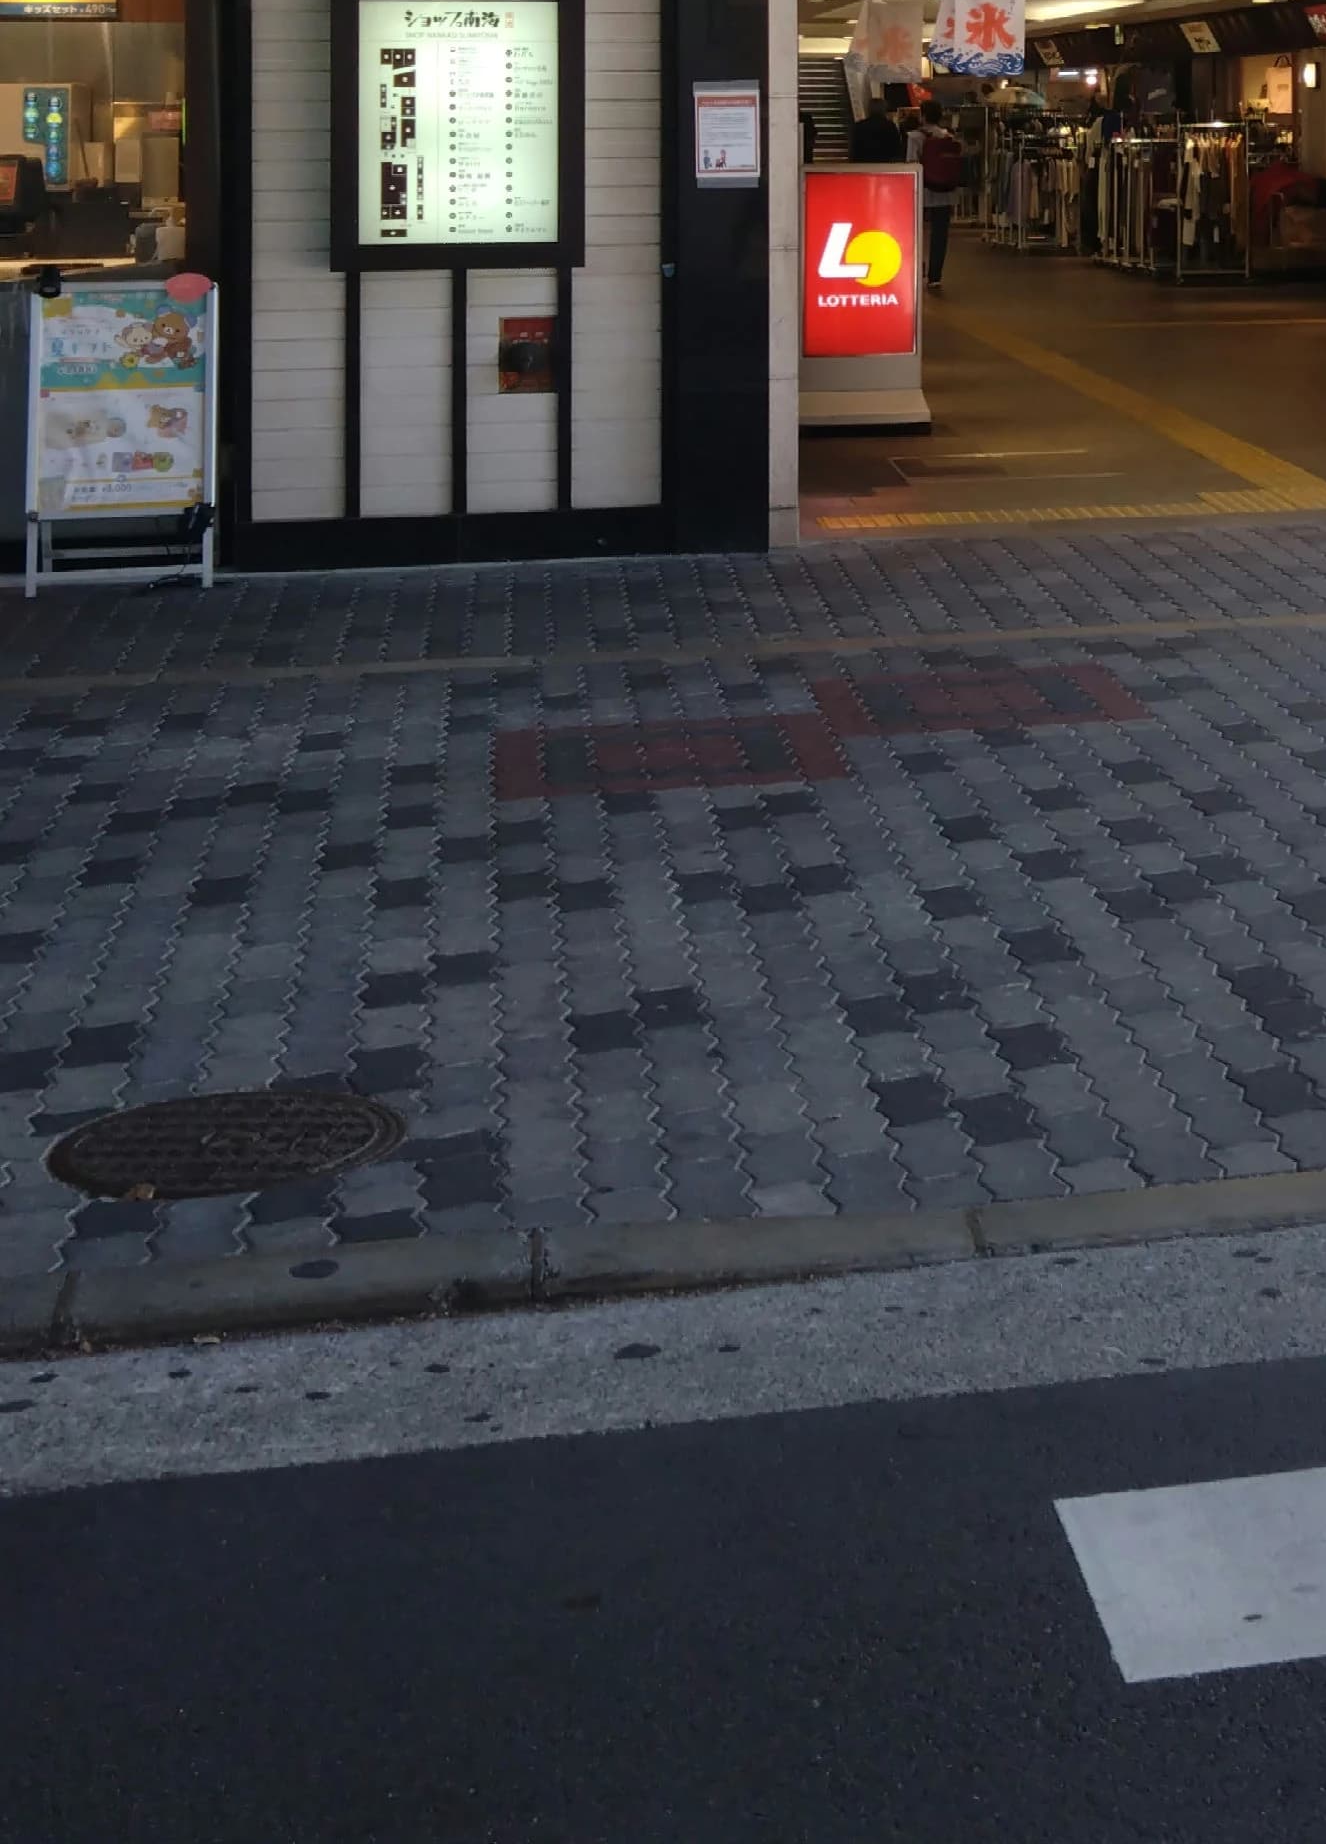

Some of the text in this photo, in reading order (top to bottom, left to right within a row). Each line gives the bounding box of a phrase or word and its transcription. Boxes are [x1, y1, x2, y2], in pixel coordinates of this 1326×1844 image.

[404, 10, 500, 28] ショップ南海
[966, 3, 1016, 52] 氷
[818, 294, 898, 307] LOTTERIA
